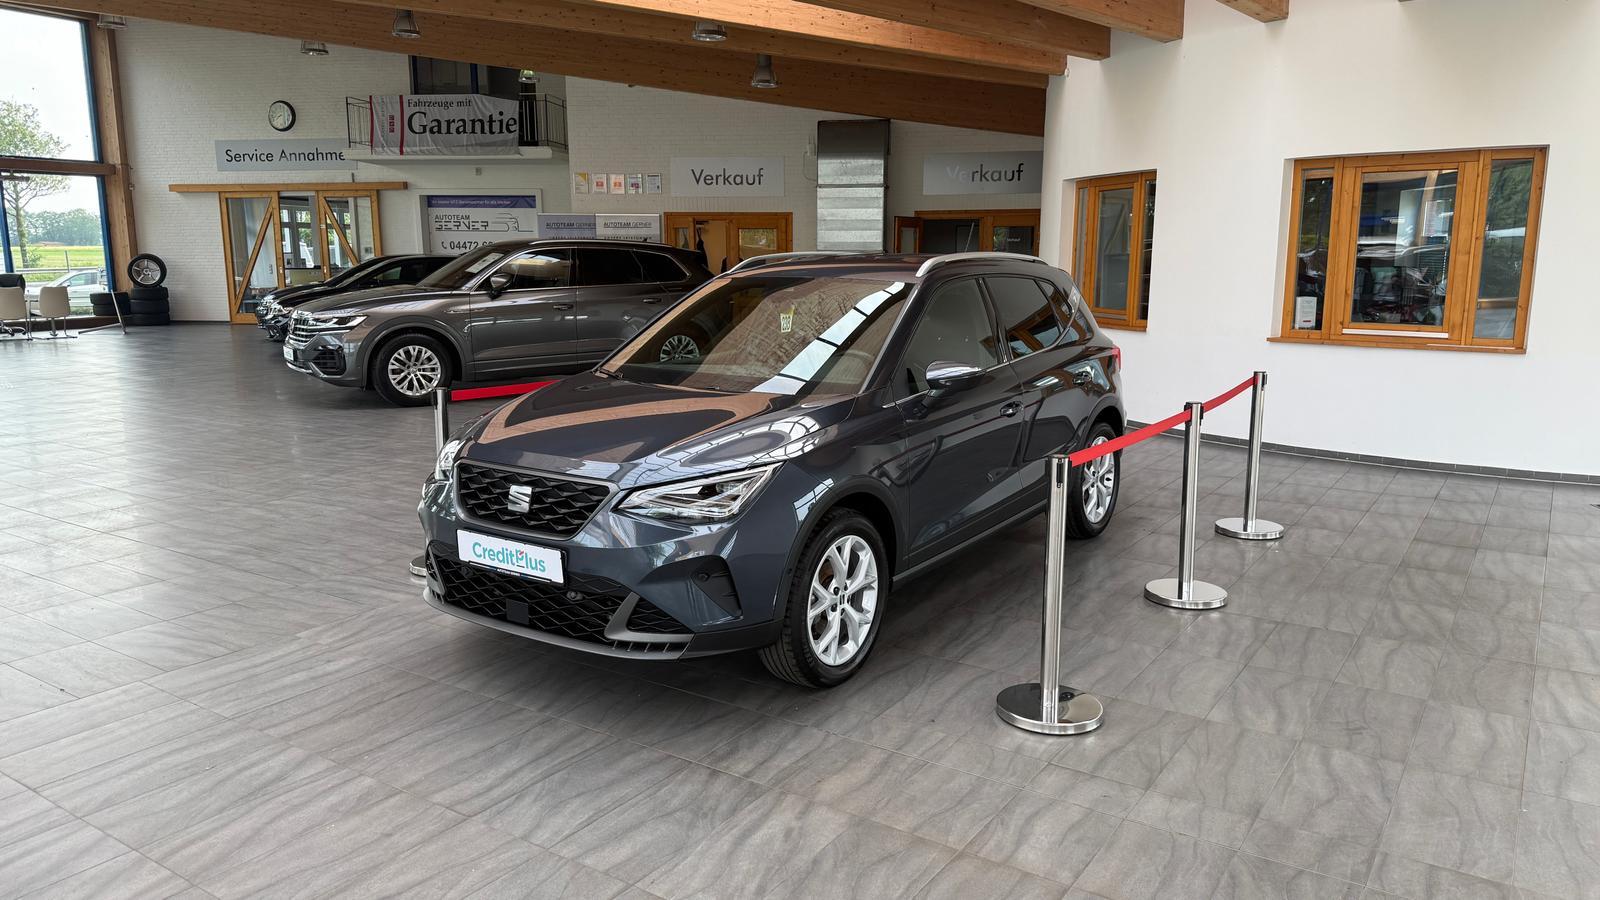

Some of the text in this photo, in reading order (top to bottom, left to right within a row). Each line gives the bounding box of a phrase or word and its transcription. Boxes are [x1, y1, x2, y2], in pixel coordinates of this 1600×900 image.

[407, 98, 473, 110] Fahrzeuge mit
[407, 111, 517, 135] Garantie
[225, 147, 346, 162] Service Annahme
[691, 167, 764, 186] Verkauf
[945, 162, 1025, 182] Verkauf
[449, 241, 479, 250] 04472
